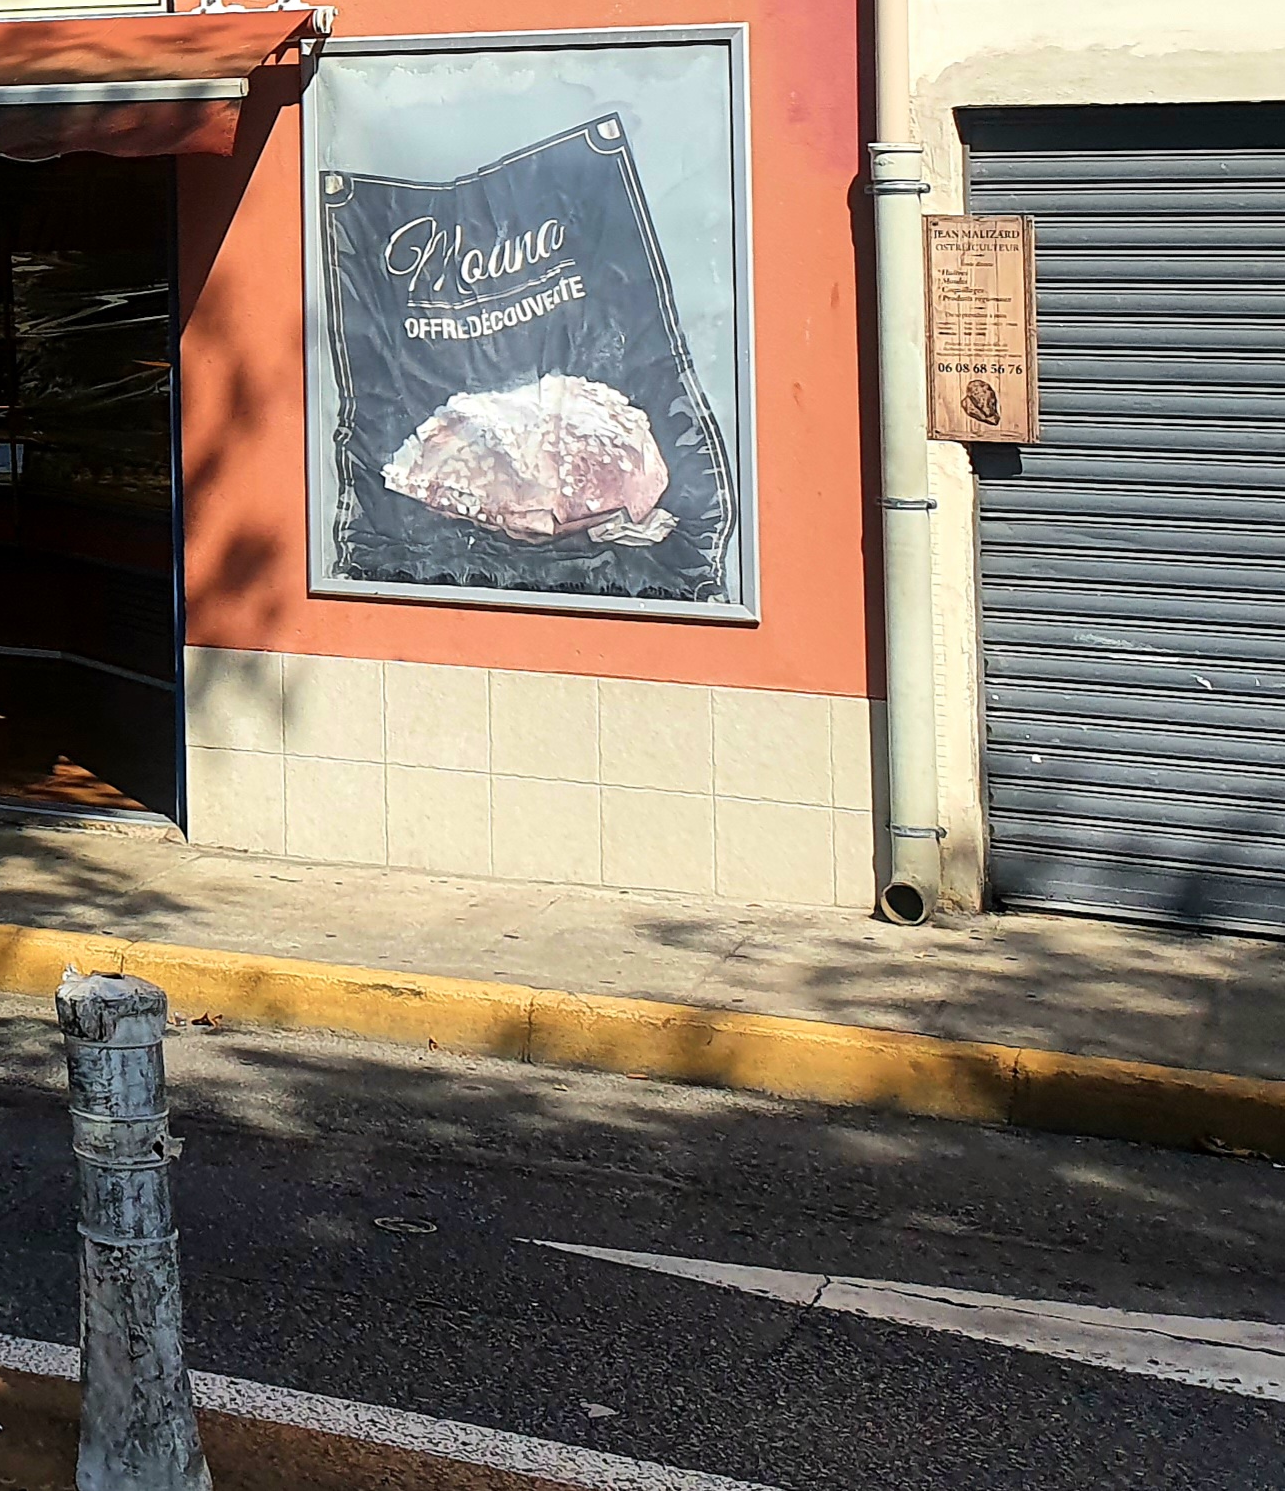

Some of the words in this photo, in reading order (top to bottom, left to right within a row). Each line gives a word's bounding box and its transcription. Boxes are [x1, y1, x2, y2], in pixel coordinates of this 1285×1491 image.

[933, 229, 959, 239] JEAN
[961, 229, 1020, 239] MALIZARD
[938, 362, 953, 373] 06
[955, 362, 970, 373] 08
[972, 363, 988, 374] 68
[990, 363, 1005, 374] 56
[1007, 363, 1023, 375] 76
